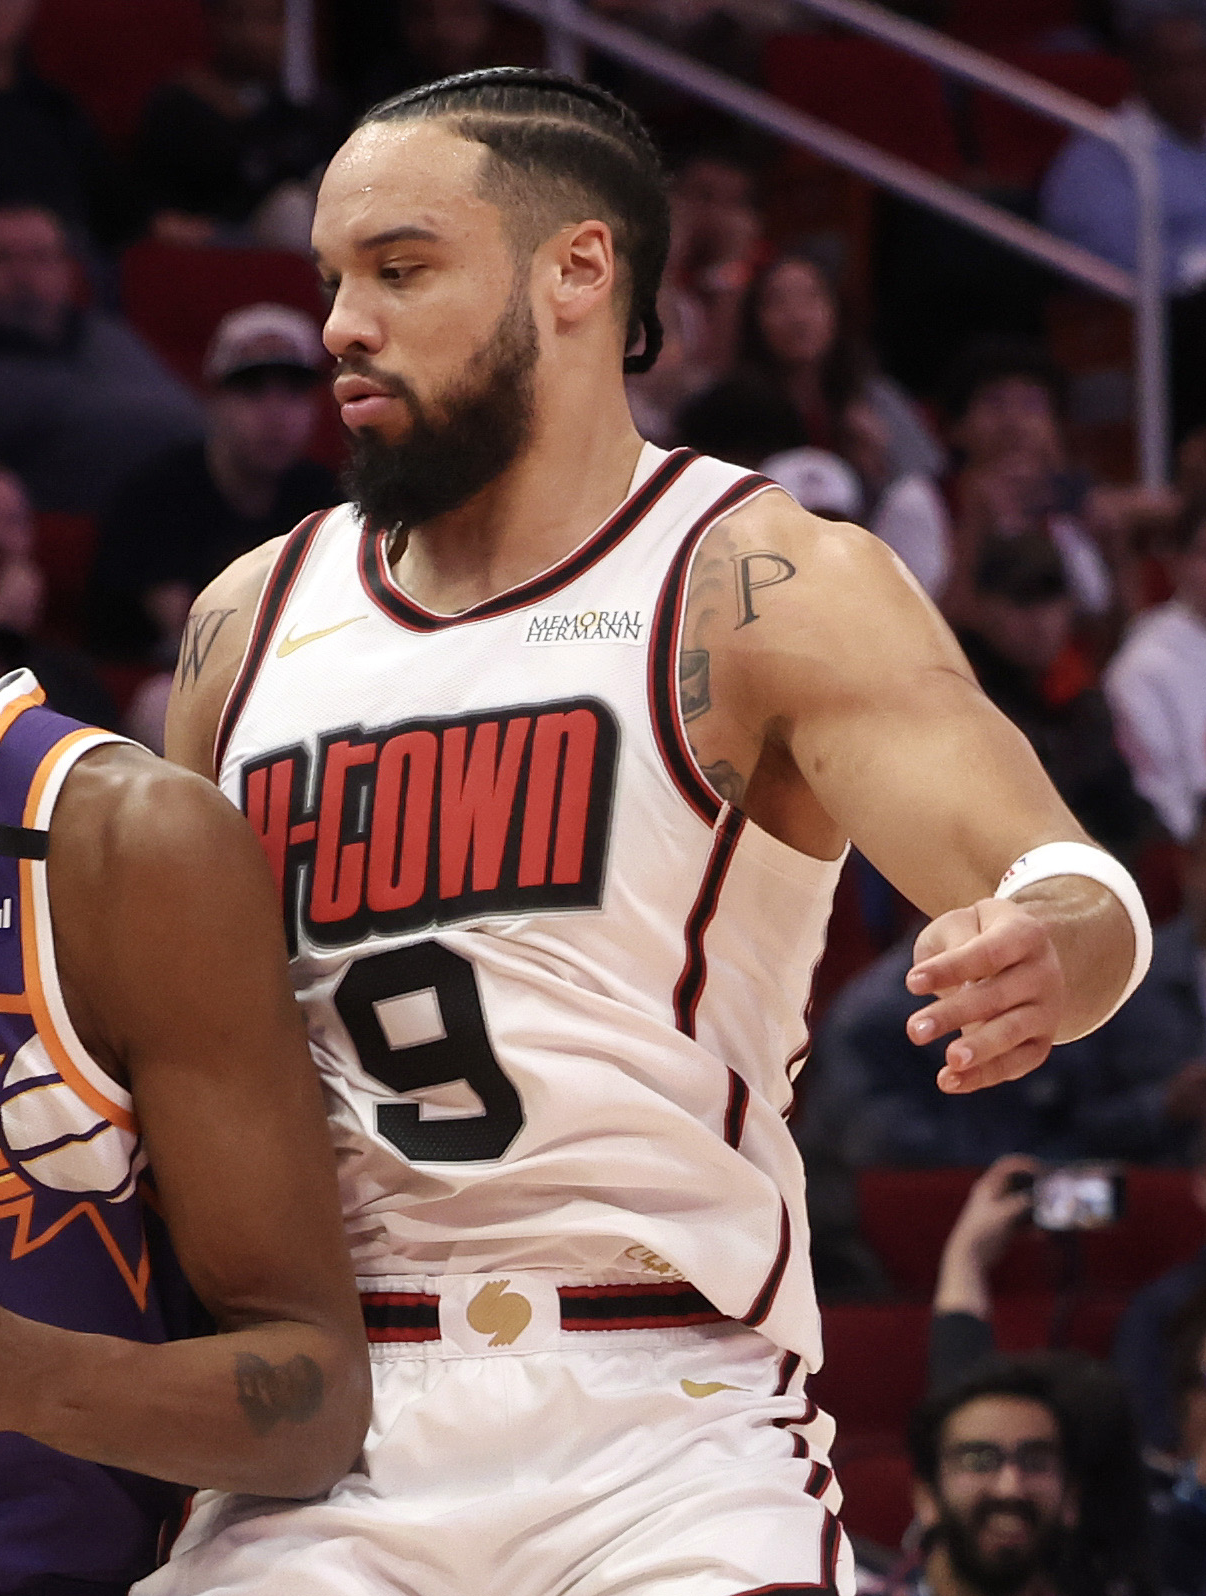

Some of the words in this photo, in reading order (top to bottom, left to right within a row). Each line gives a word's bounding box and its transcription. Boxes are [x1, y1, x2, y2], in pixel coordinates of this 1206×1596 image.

[730, 550, 796, 630] P
[526, 624, 643, 642] HERMANN
[529, 611, 643, 630] MEMORIAL
[334, 940, 526, 1165] 9
